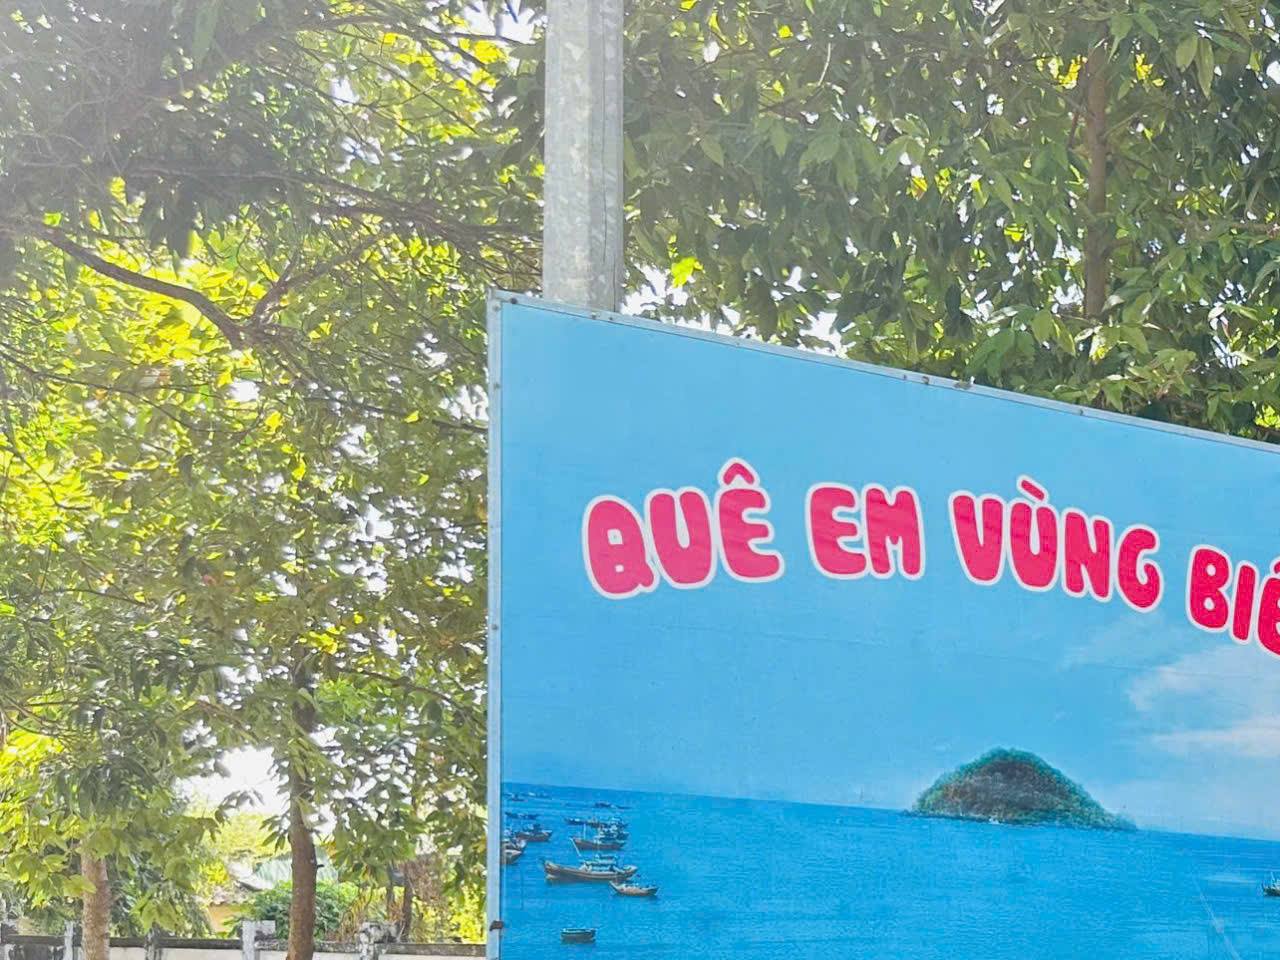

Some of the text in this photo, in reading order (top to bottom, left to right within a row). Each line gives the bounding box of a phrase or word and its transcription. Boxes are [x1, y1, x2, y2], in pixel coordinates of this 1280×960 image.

[586, 460, 782, 596] QUÊ
[808, 485, 923, 577] EM
[951, 478, 1163, 611] VÙNG
